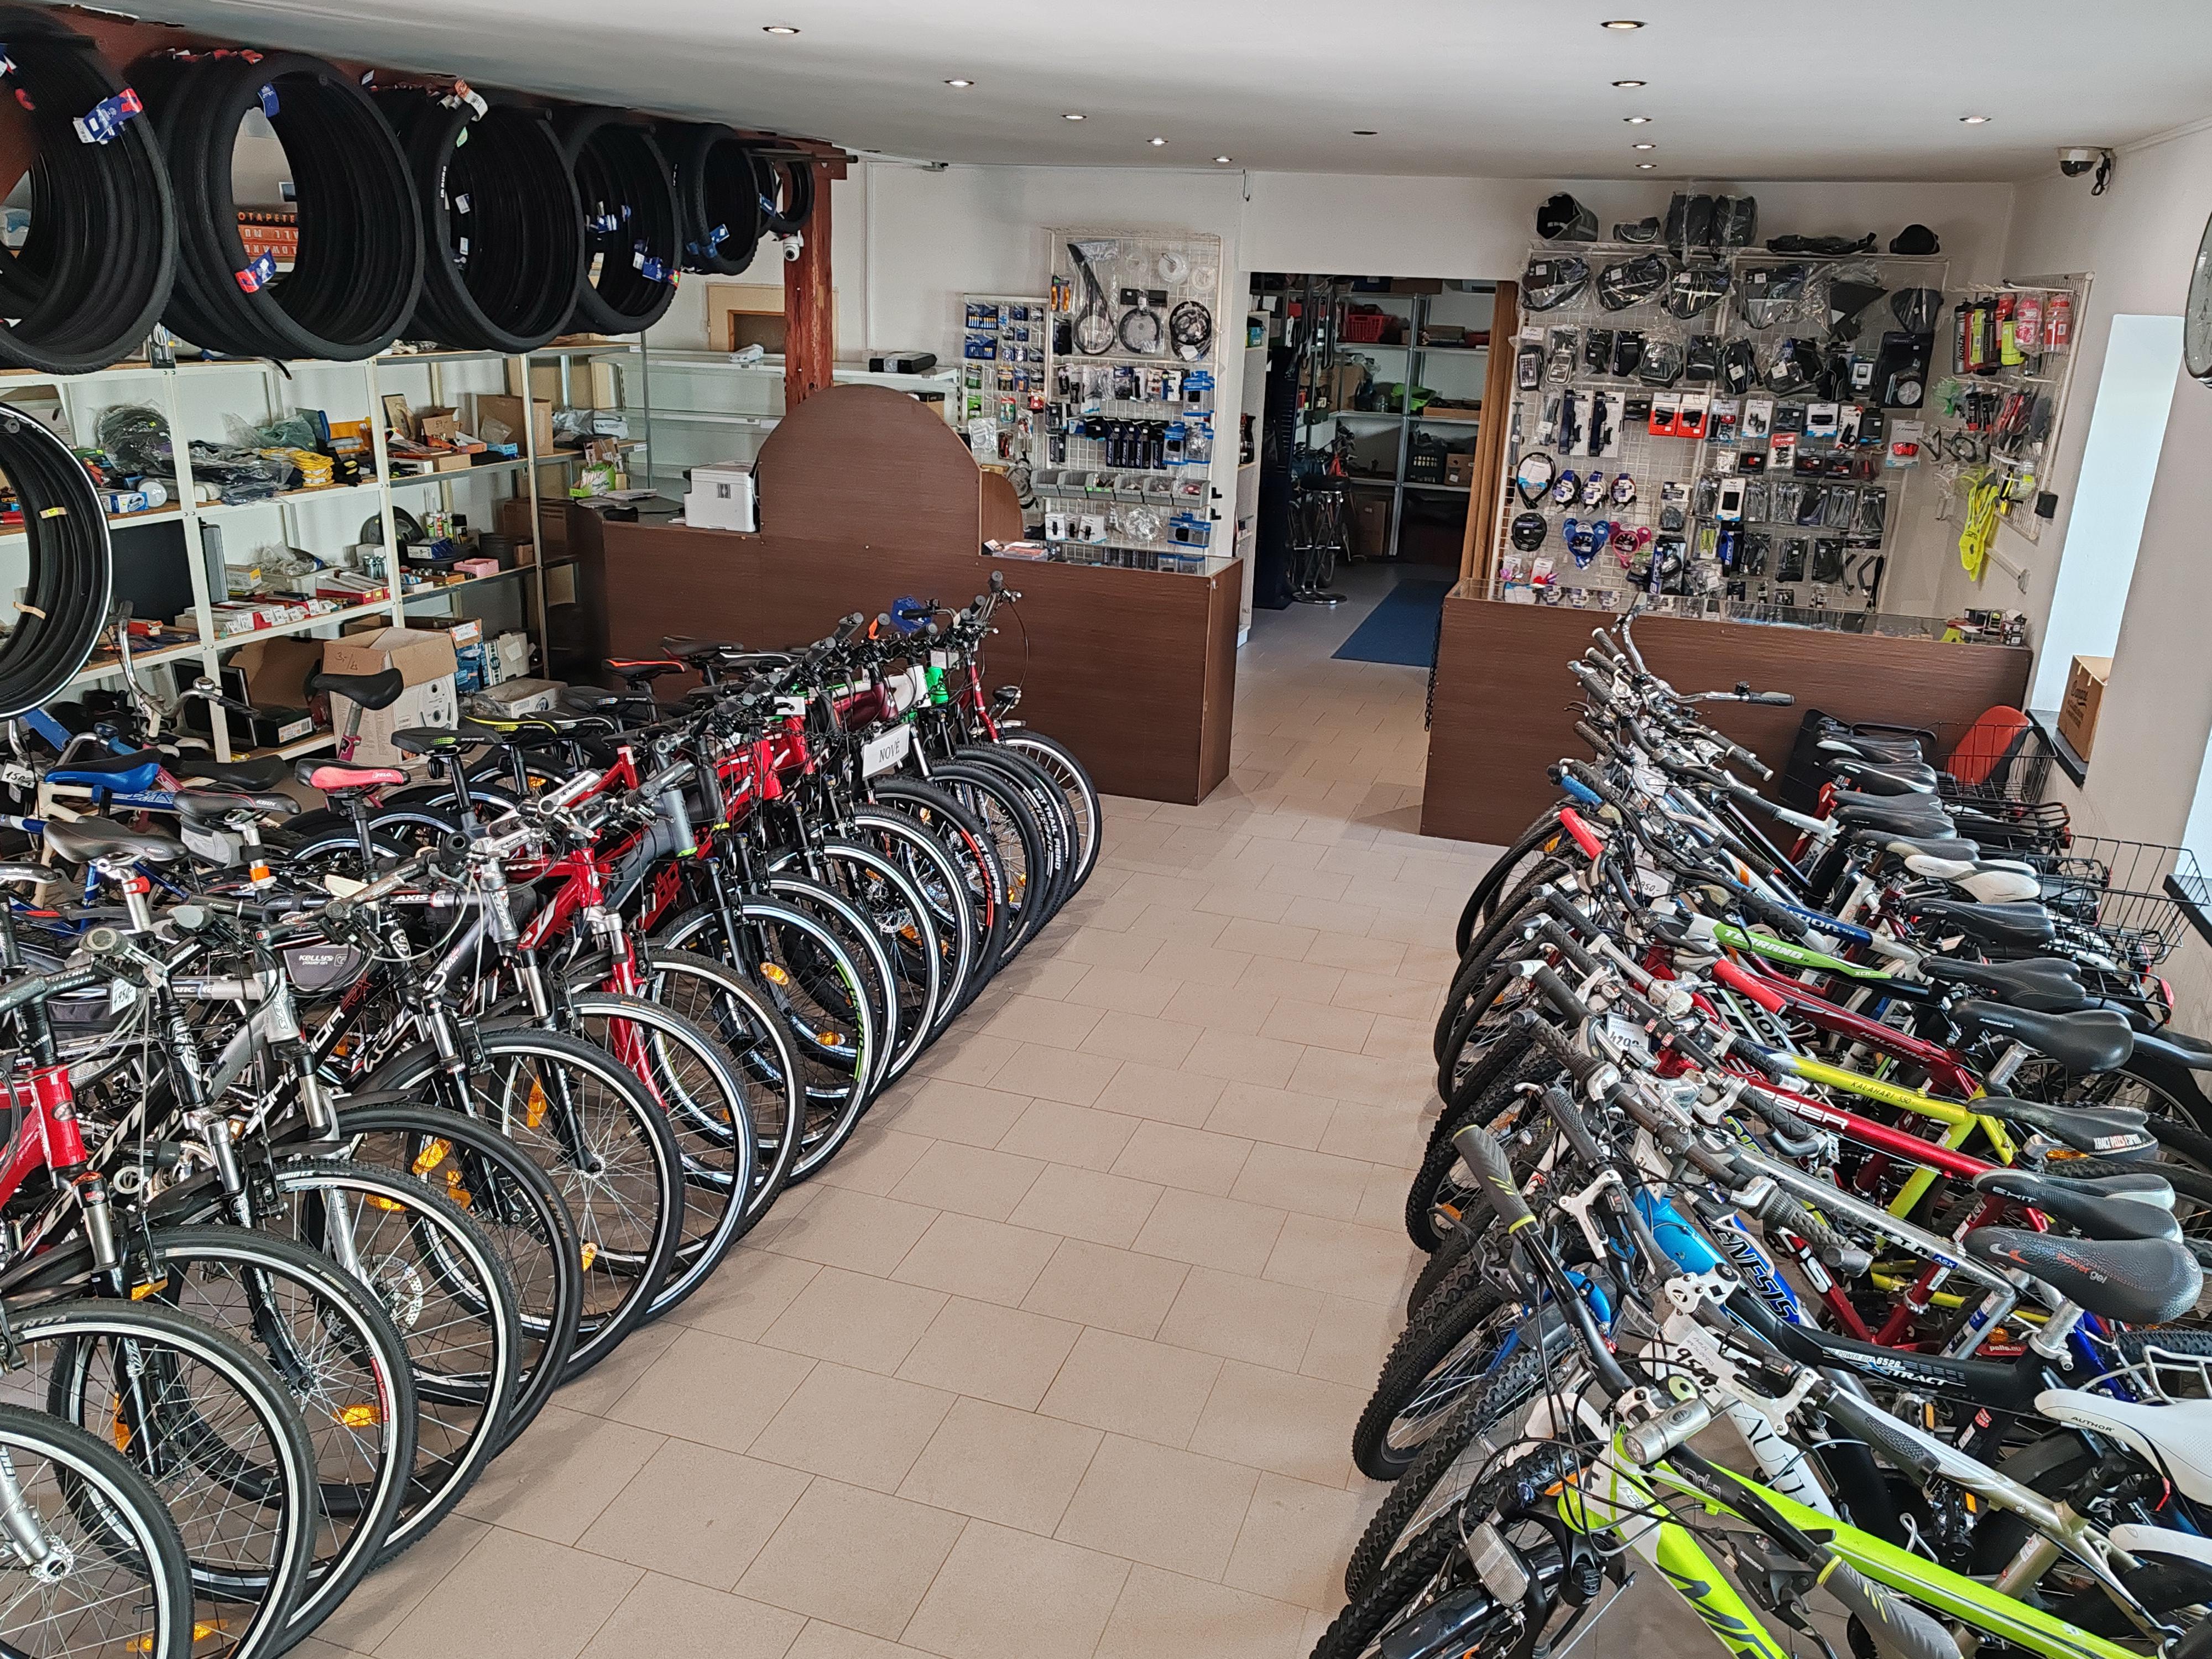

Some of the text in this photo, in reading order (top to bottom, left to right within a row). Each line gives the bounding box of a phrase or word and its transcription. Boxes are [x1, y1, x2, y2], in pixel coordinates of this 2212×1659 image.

[1652, 554, 1661, 582] FORCE
[879, 740, 900, 763] NOVÉ
[1032, 788, 1047, 804] CST
[1044, 804, 1058, 834] TRAIL
[973, 833, 1001, 905] CST GRIPPER
[394, 894, 429, 902] AXIS
[1979, 1018, 2014, 1029] MERIDA
[31, 1034, 51, 1048] SATORI
[1859, 1032, 1931, 1062] KALAHARI
[1851, 1081, 1912, 1104] KALAHARI 550
[1992, 1186, 2038, 1203] EXIT
[546, 1193, 569, 1239] KENDA
[1866, 1222, 1957, 1268] BETA ASX
[2089, 1270, 2106, 1284] gel
[9, 1315, 68, 1332] ENDA
[1837, 1350, 1860, 1360] POWER
[1876, 1355, 1901, 1368] 6526
[2070, 1416, 2113, 1432] AUTHOR
[1740, 1550, 1765, 1573] SHIMANO
